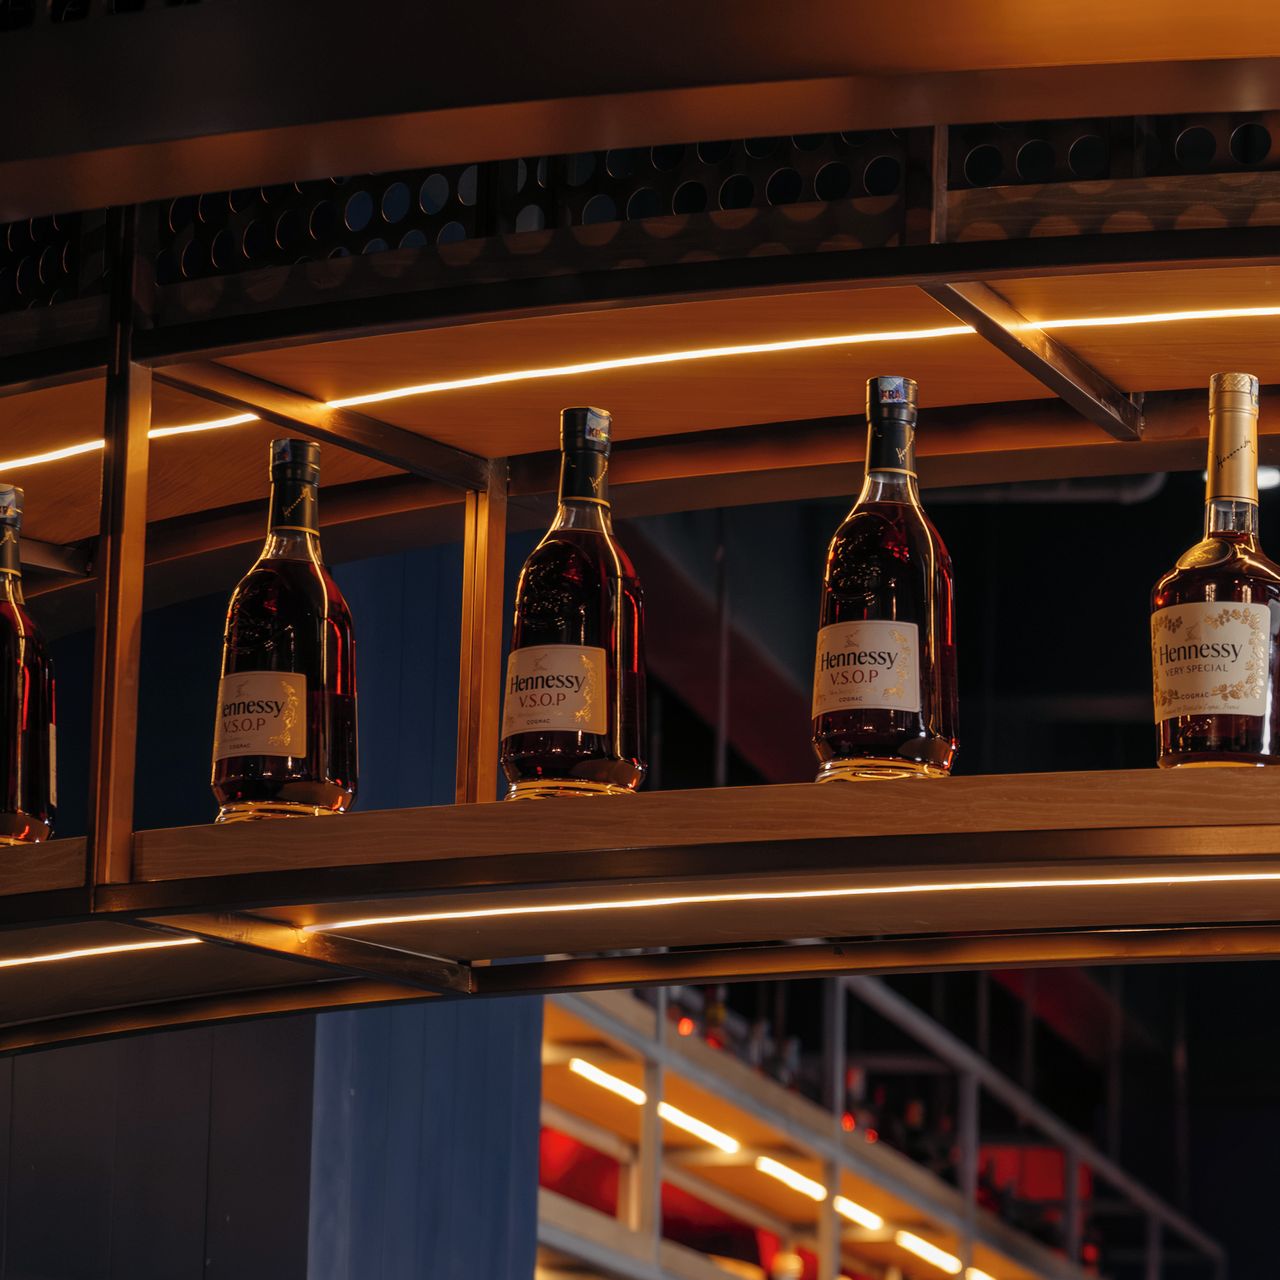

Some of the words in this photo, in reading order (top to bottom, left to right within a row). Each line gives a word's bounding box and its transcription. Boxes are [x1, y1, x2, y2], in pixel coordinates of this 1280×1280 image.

[820, 650, 898, 672] Hennessy
[1159, 642, 1243, 665] Hennessy
[830, 669, 879, 685] V.S.O.P
[1166, 665, 1184, 677] VERY
[1186, 663, 1229, 674] SPECIAL
[510, 674, 586, 694] Hennessy
[519, 693, 567, 708] V.S.O.P
[1180, 691, 1209, 700] COGNAC
[222, 700, 286, 718] ennessy
